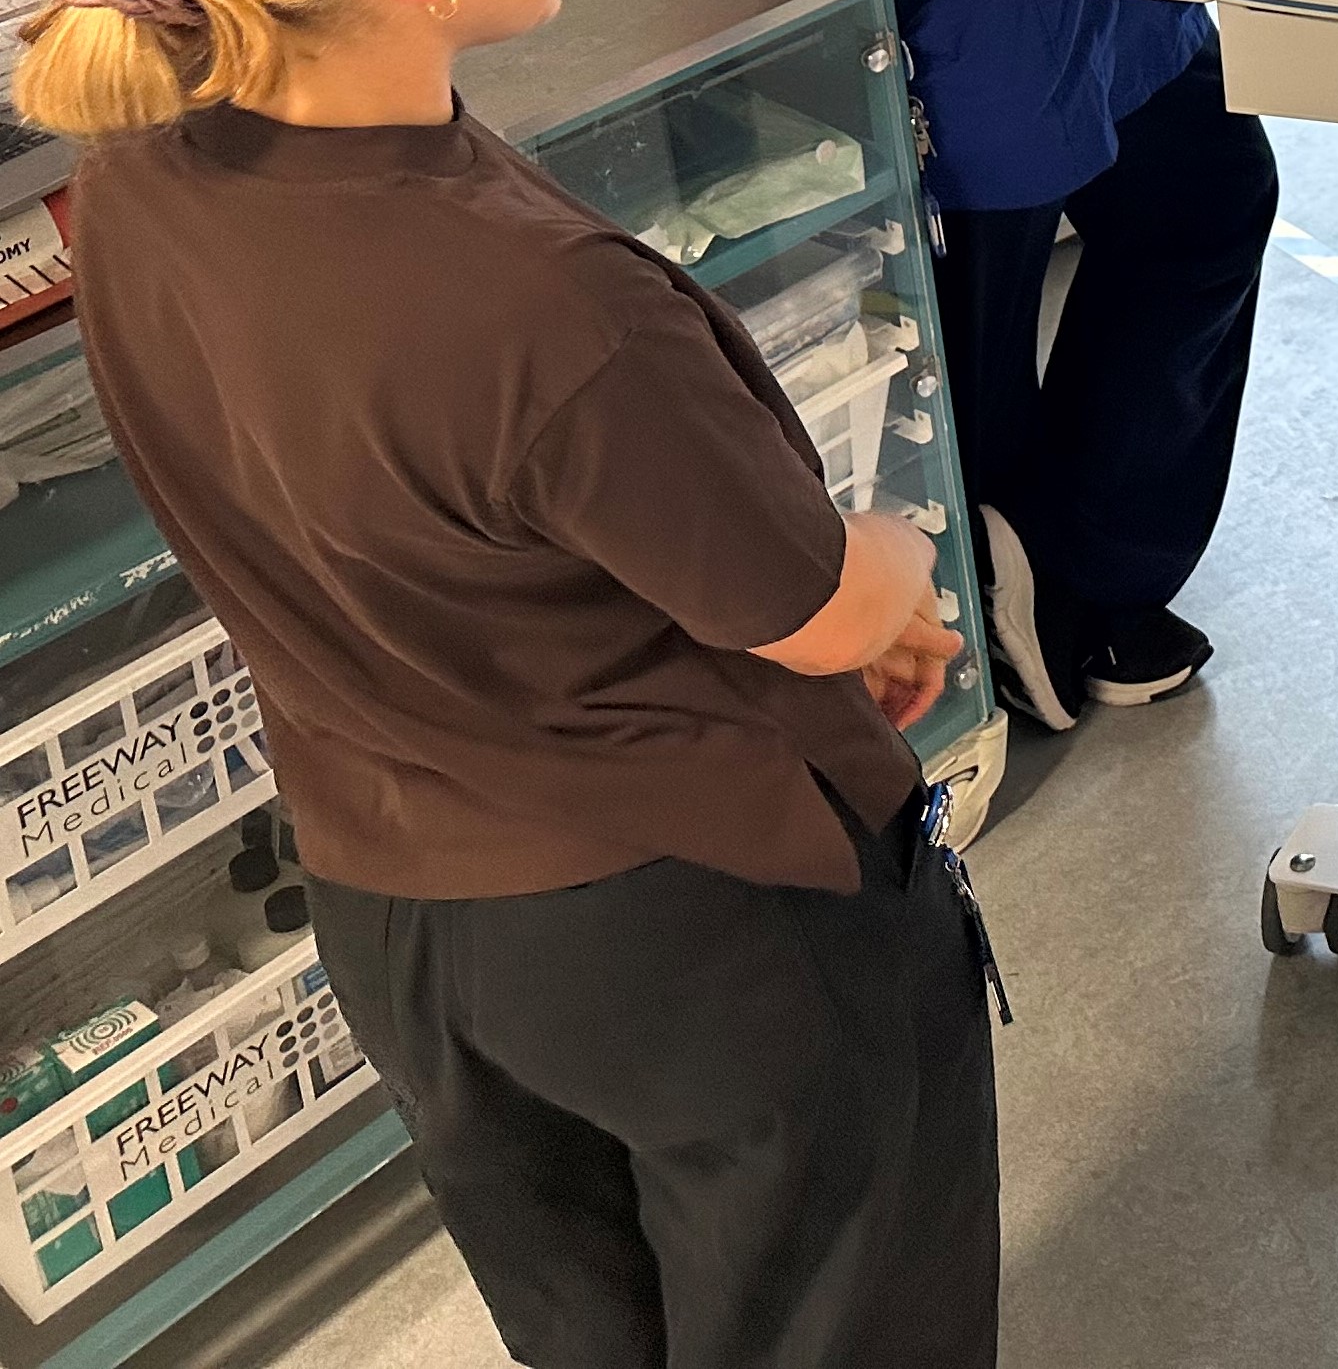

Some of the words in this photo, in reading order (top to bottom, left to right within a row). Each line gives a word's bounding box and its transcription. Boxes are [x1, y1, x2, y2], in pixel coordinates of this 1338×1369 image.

[16, 712, 184, 829] FREEWAY
[21, 744, 189, 858] Medical
[116, 1039, 270, 1156] FREEWAY
[119, 1056, 276, 1184] Medical
